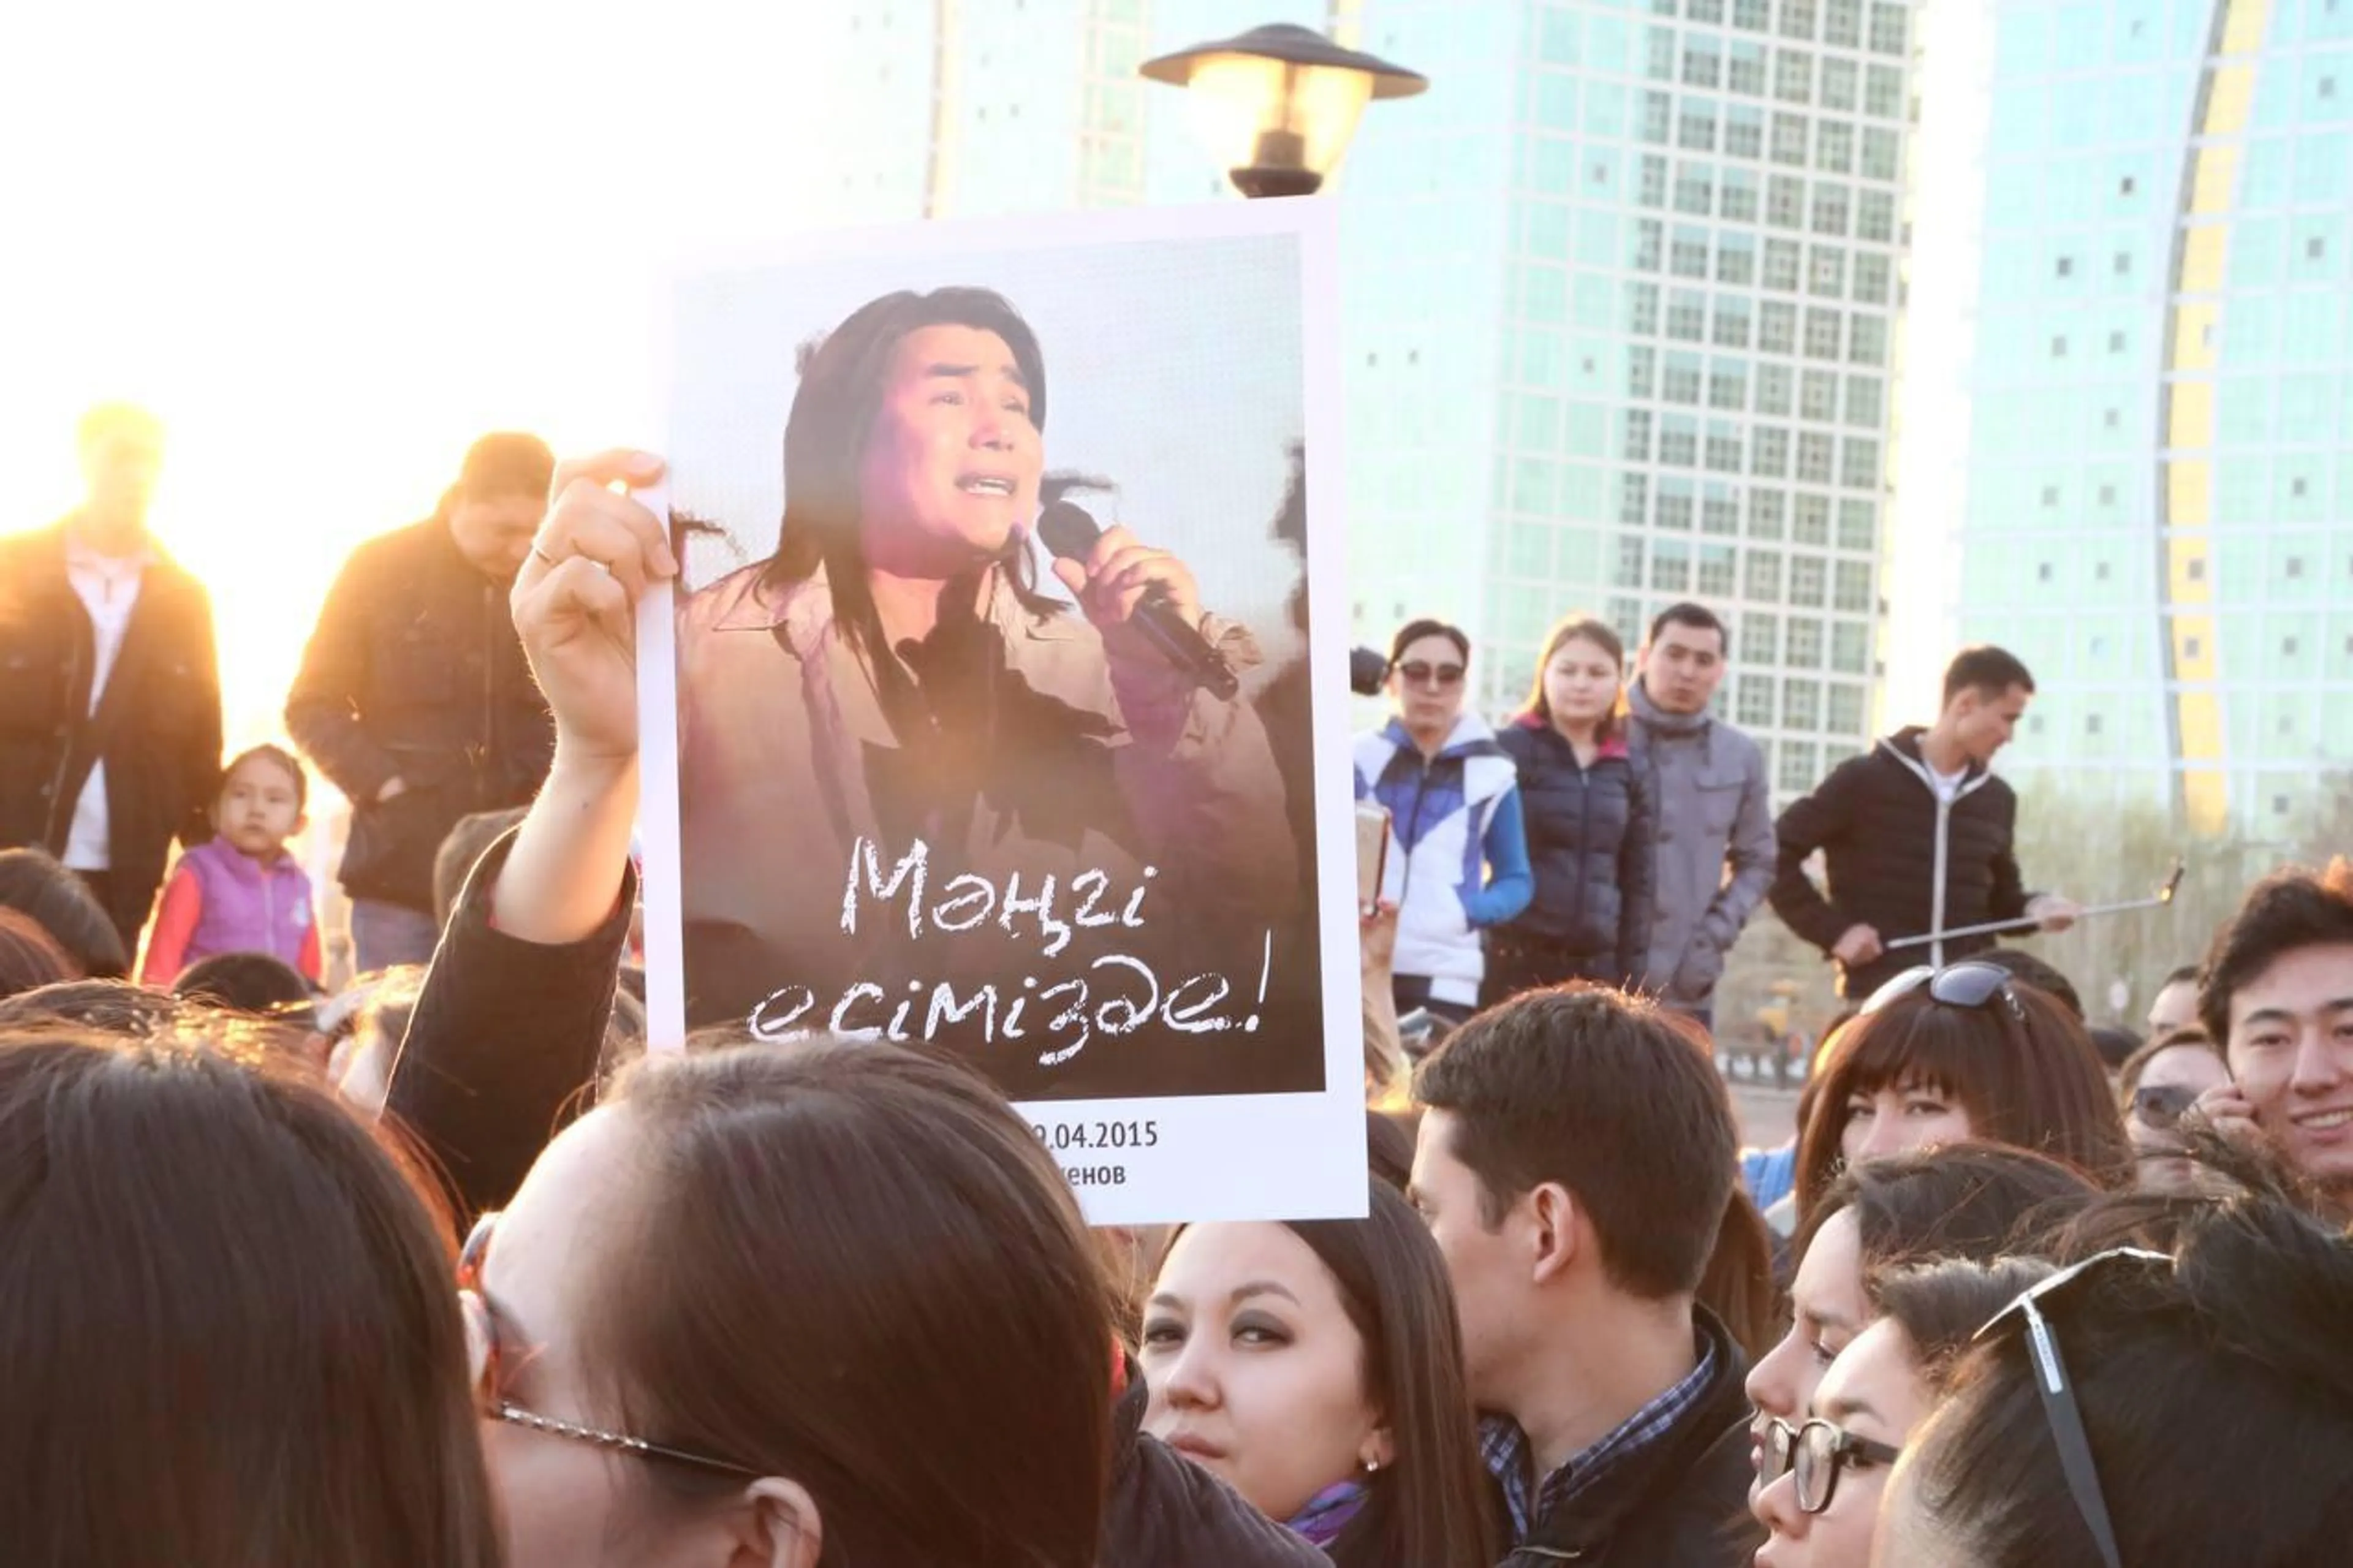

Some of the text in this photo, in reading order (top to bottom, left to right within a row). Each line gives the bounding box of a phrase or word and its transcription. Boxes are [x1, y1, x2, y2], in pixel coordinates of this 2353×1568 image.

[839, 835, 1158, 956] Мәңгі
[746, 929, 1271, 1066] есімізде!
[1061, 1165, 1126, 1186] енов
